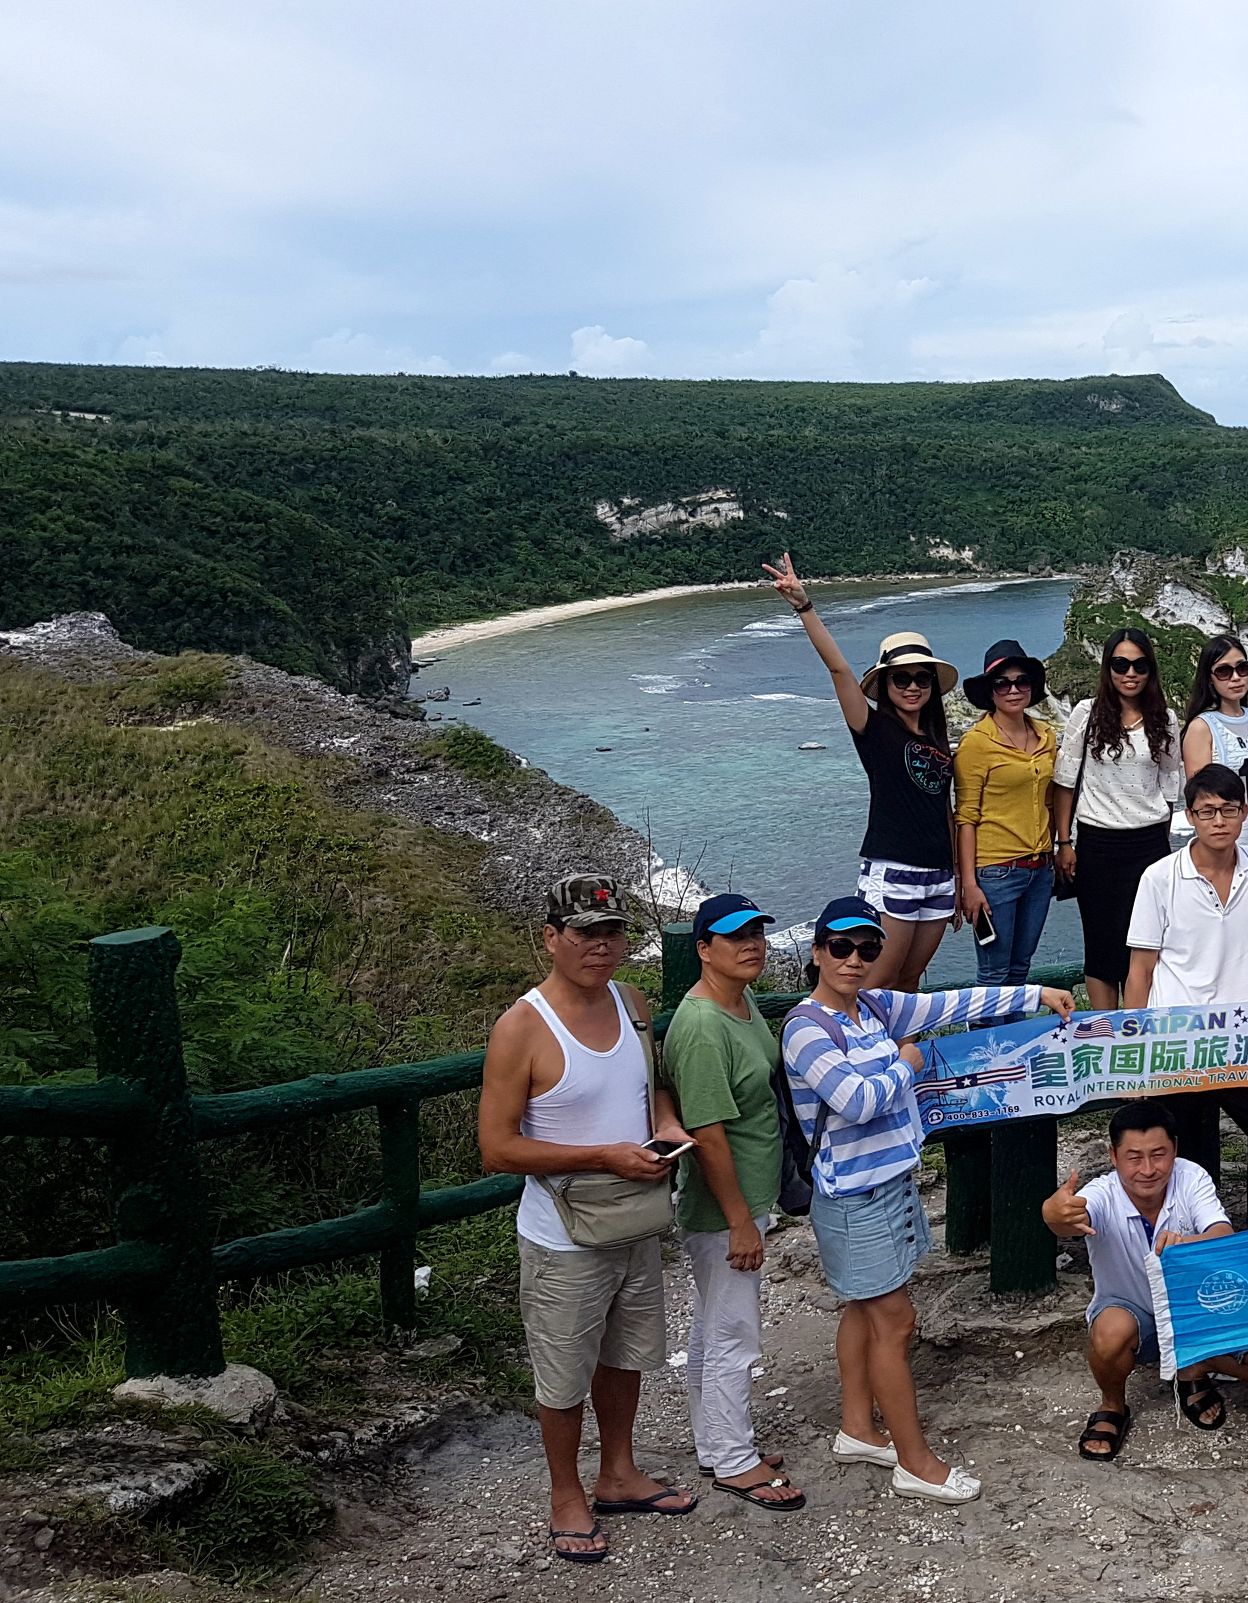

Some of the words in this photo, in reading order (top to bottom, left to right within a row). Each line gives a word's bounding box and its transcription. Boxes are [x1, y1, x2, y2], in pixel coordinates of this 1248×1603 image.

[1122, 1011, 1227, 1038] SAIPAN
[1034, 1090, 1081, 1107] ROYAL
[1083, 1075, 1203, 1096] INTERNATIONAL
[946, 1105, 1020, 1121] 400-833-1169
